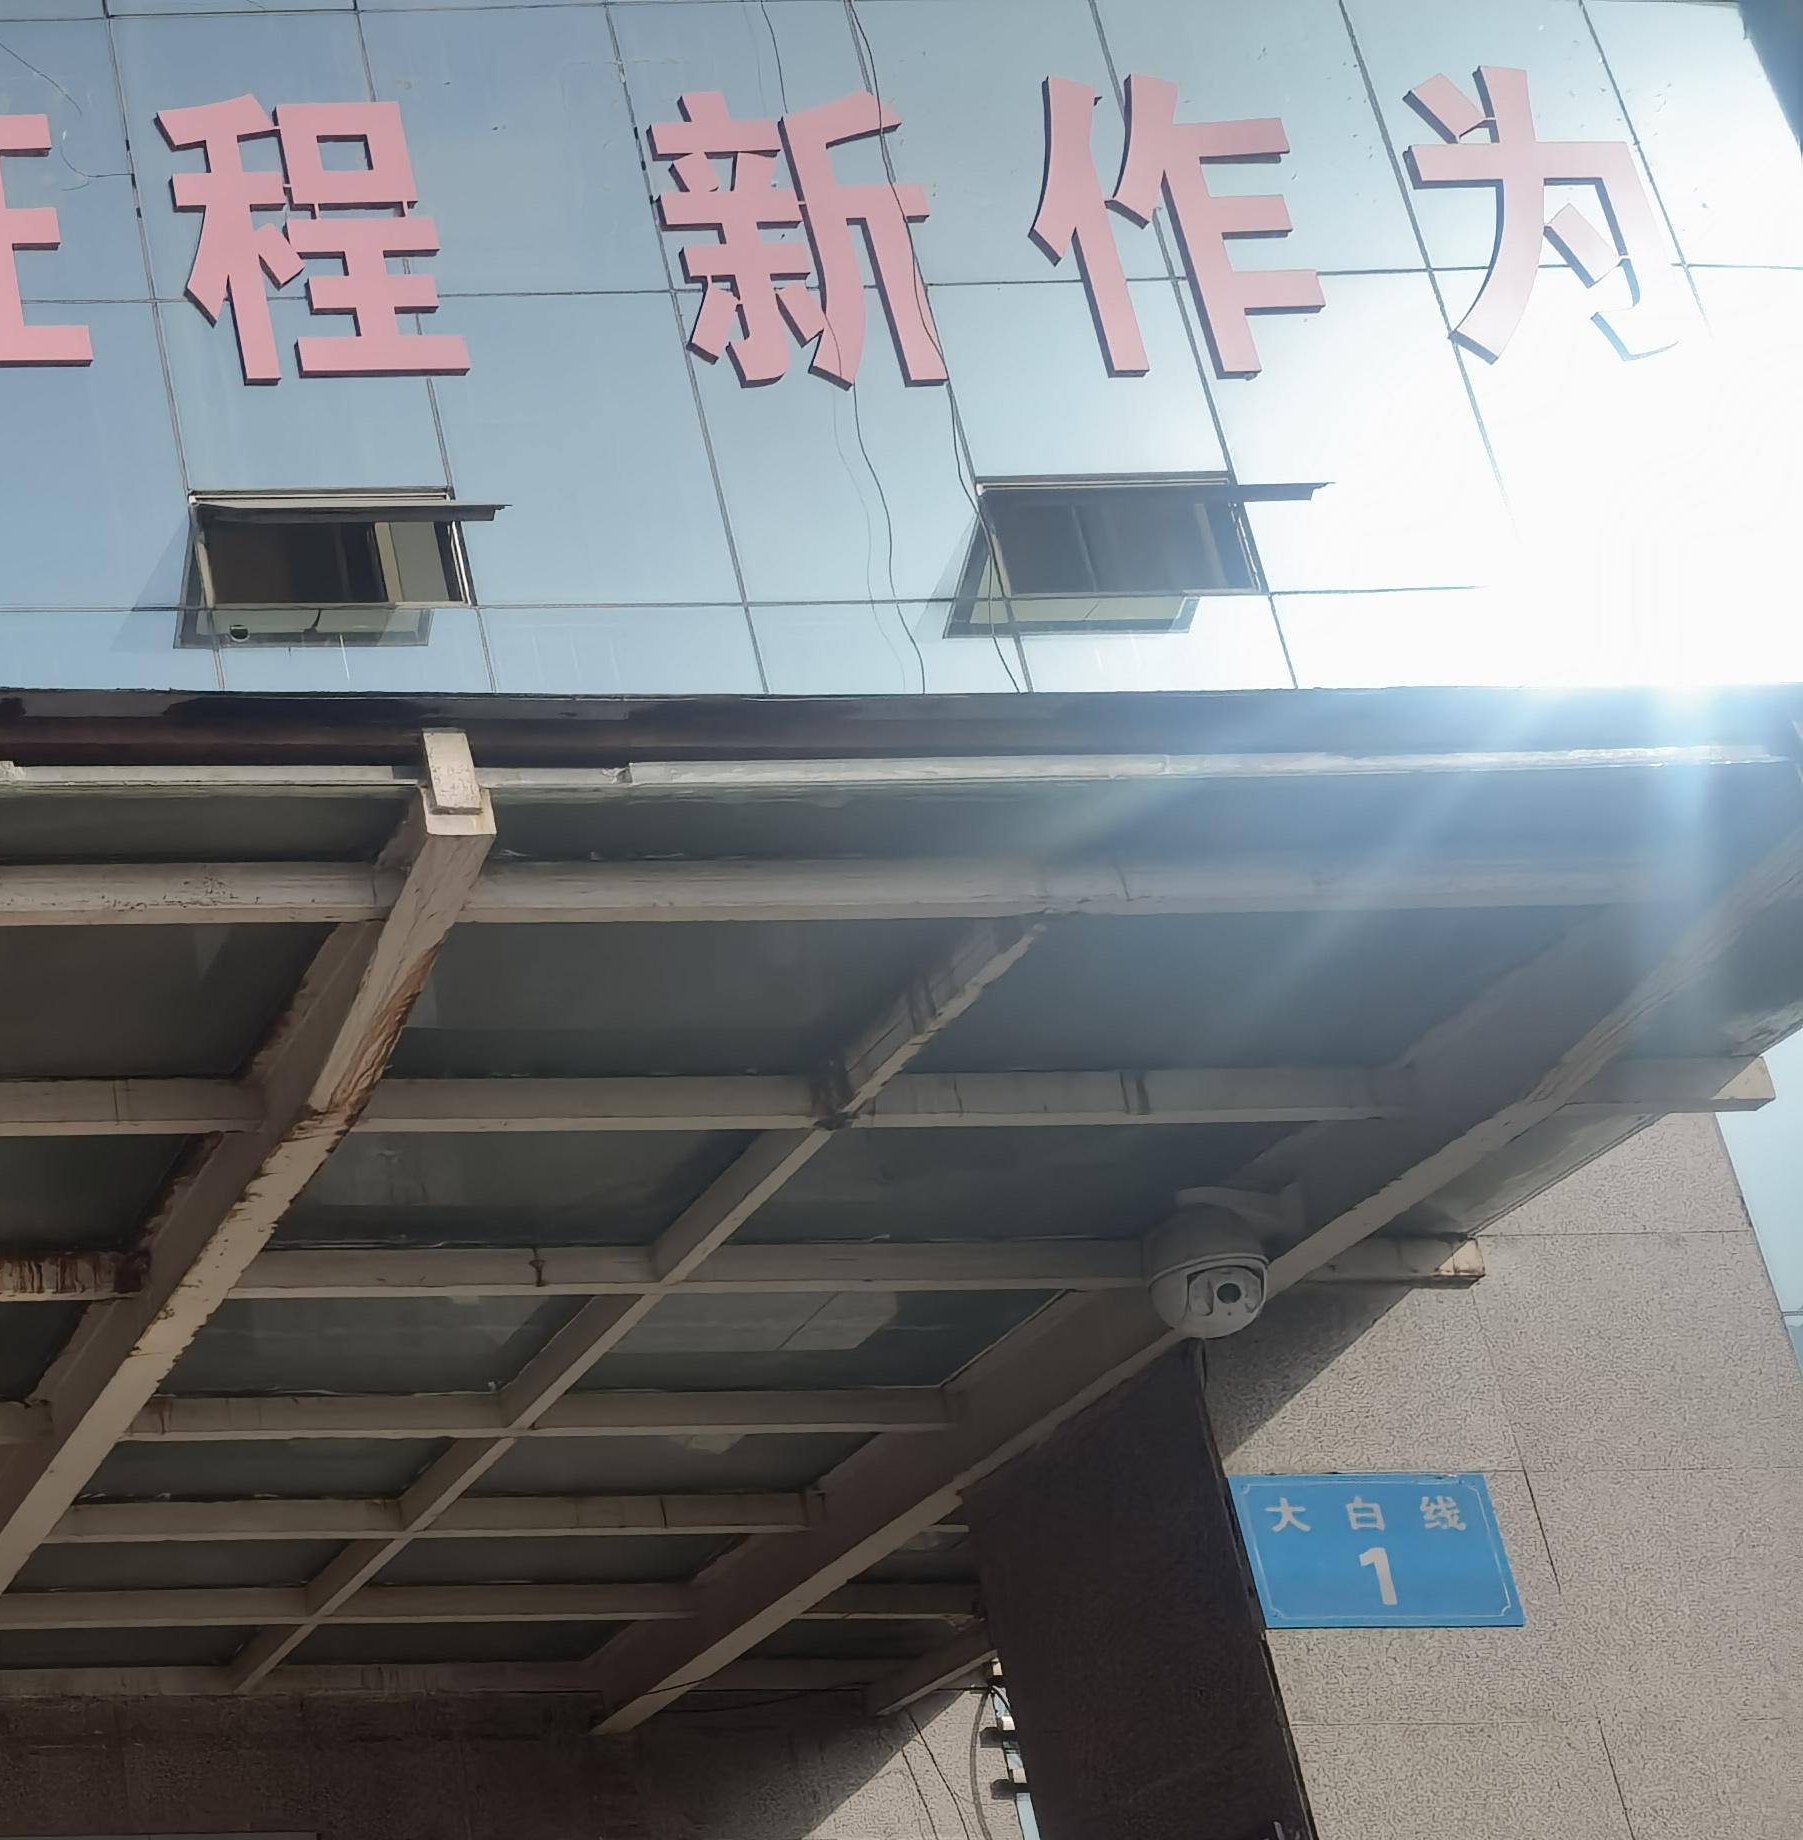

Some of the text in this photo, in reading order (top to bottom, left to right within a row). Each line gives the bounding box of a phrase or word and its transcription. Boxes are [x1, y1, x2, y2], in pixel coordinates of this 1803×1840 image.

[649, 64, 1683, 387] 新作为
[1264, 1495, 1467, 1532] 大白线
[1359, 1547, 1398, 1605] 1
